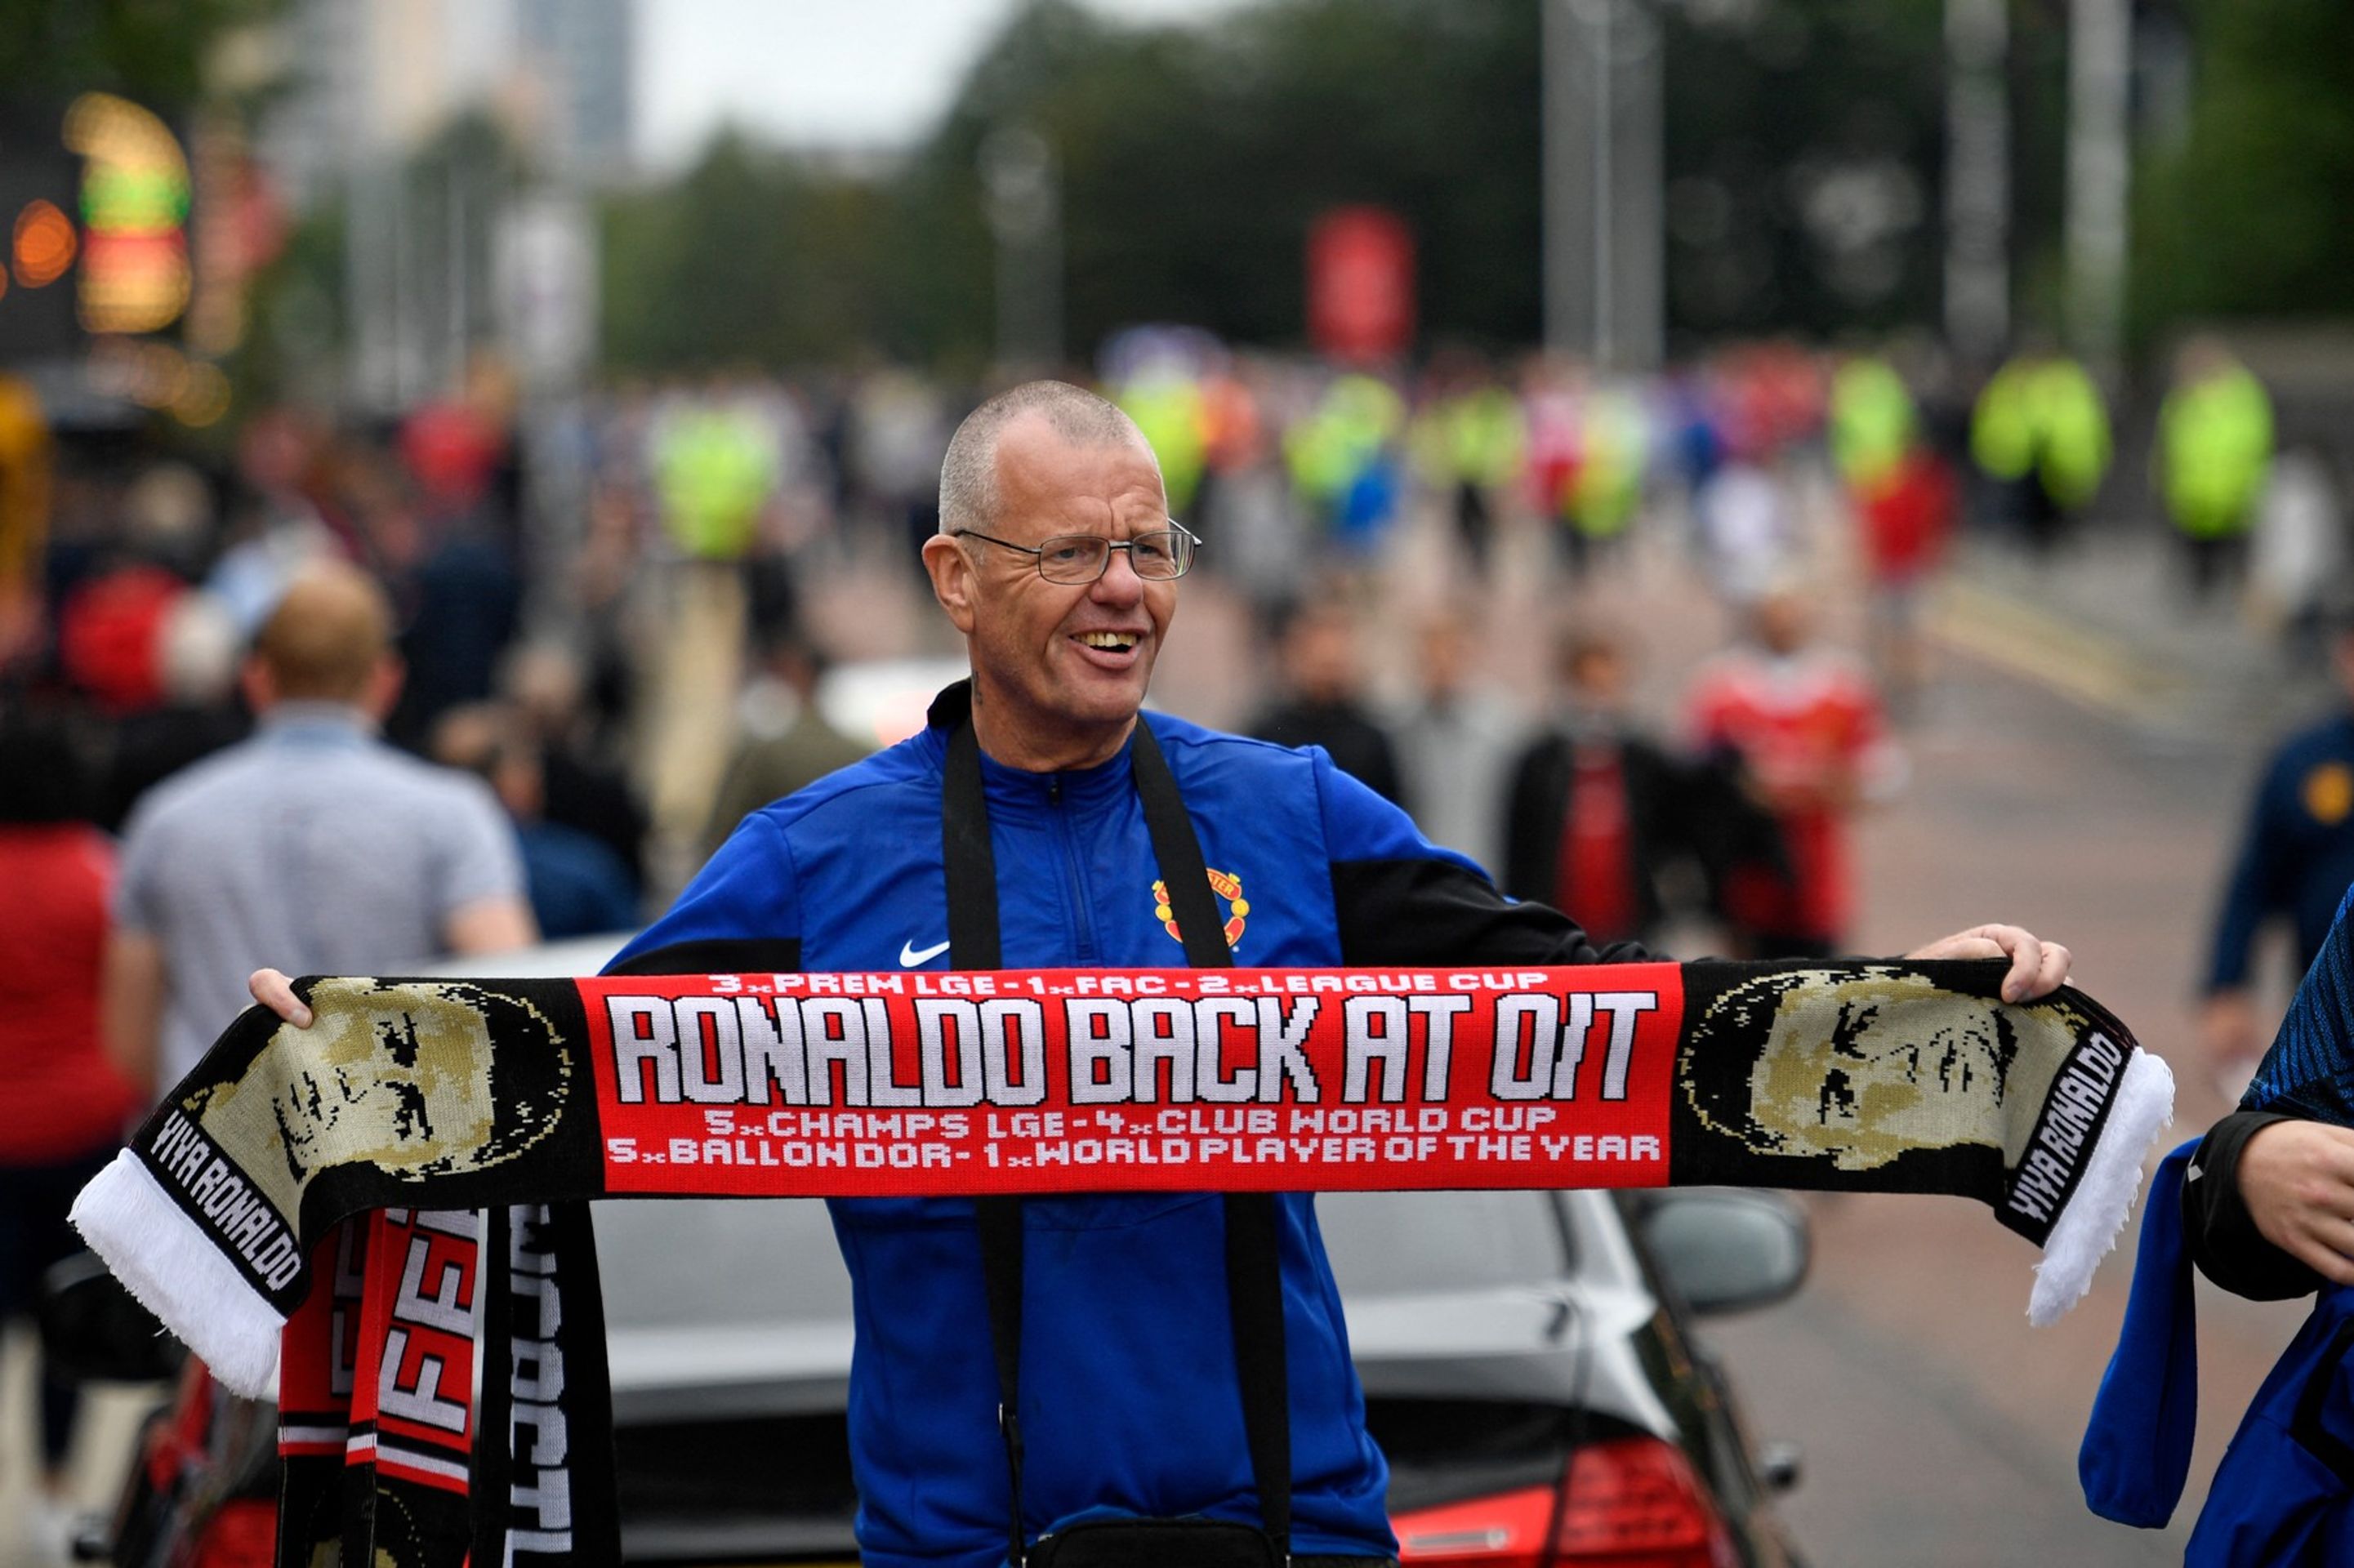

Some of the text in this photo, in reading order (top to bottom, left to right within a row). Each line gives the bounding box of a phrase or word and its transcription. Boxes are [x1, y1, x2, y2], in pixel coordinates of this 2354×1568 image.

[1447, 972, 1549, 991] CUP
[606, 995, 1045, 1107] RONALDO
[1064, 993, 1322, 1106] BACK
[1344, 993, 1473, 1104] AT
[1290, 1108, 1448, 1134] WORLD
[1461, 1107, 1557, 1132] CUP
[2040, 1031, 2123, 1167] RONALDO
[1199, 1138, 1376, 1163] PLAYER
[1384, 1137, 1438, 1161] OF
[1446, 1136, 1531, 1160] THE
[1540, 1135, 1661, 1160] YEAR
[189, 1157, 301, 1291] RONALDO
